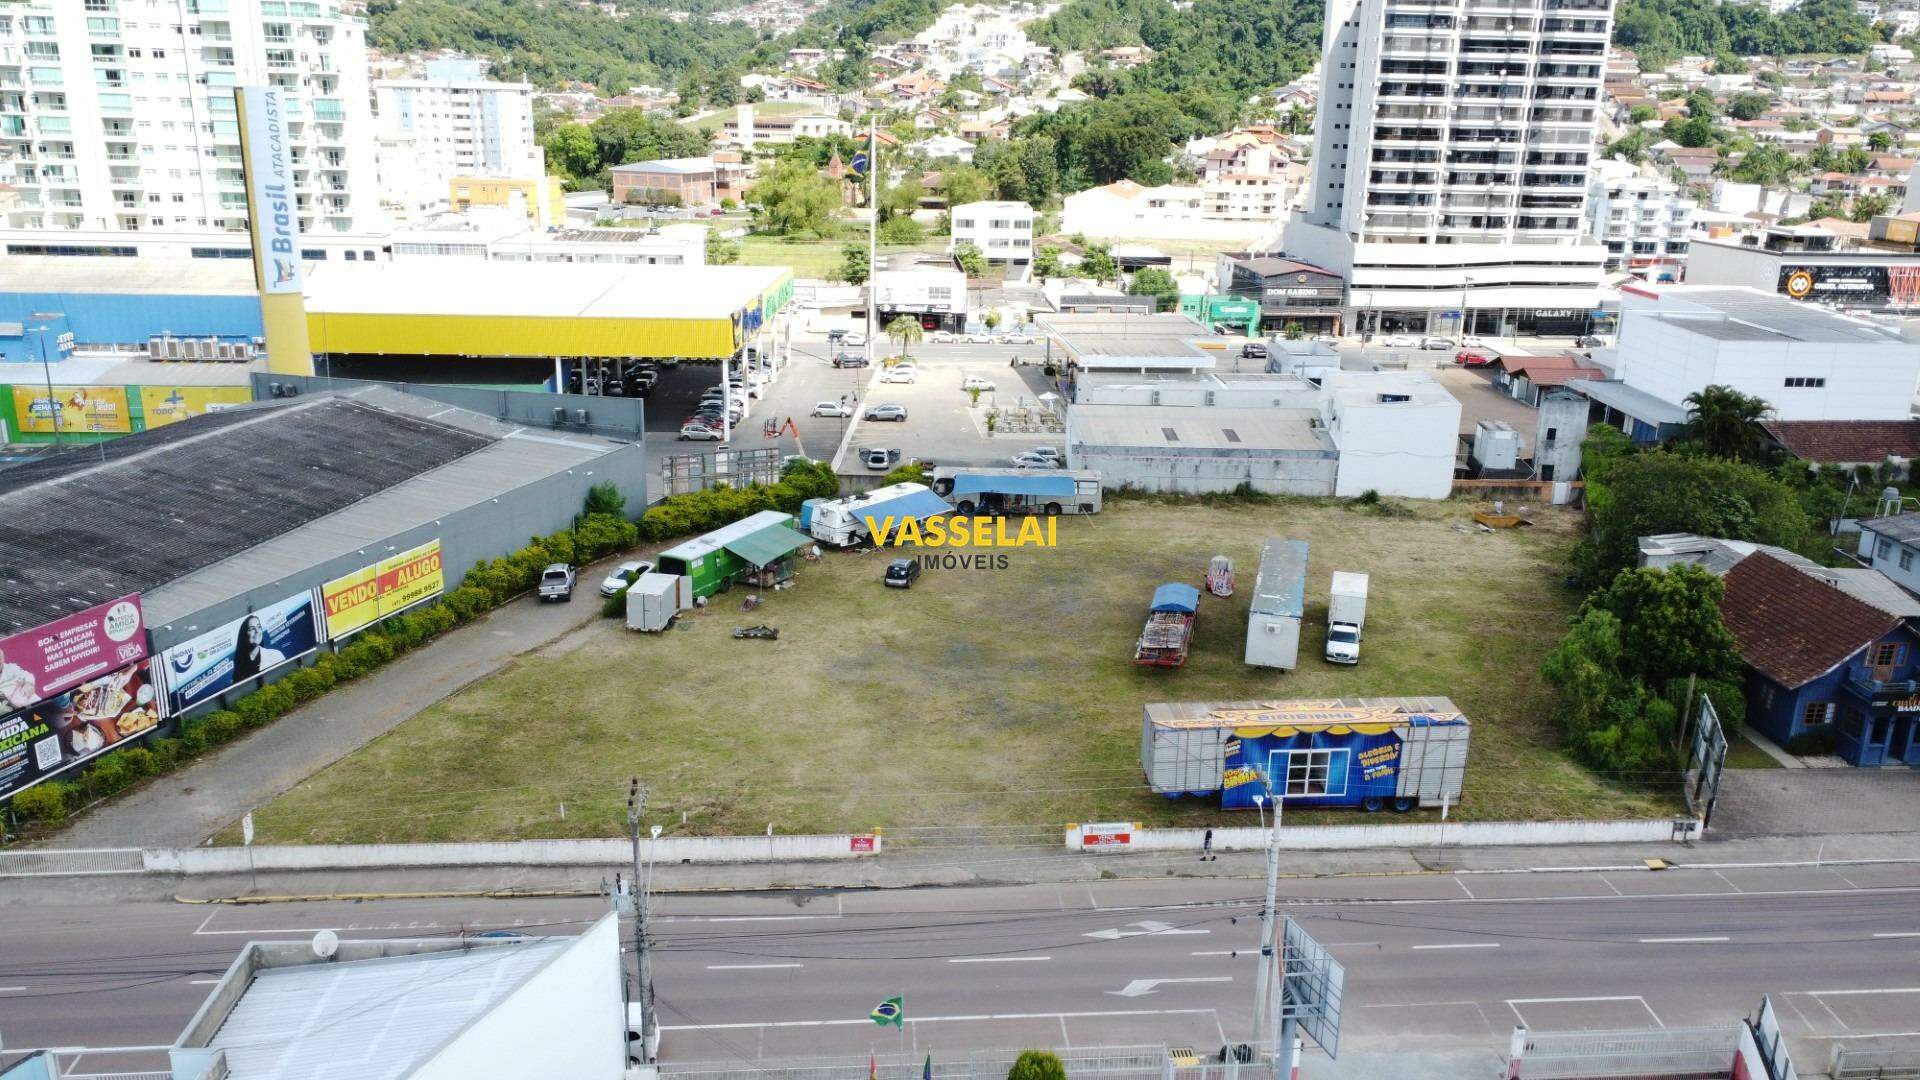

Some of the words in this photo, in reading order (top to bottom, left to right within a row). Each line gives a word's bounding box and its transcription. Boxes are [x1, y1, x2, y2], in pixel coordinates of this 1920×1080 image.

[265, 91, 284, 179] ATACADISTA
[265, 183, 293, 253] Brasil
[1535, 309, 1572, 317] GALAXY
[328, 581, 377, 614] VENDO
[397, 555, 440, 586] ALUGO
[59, 619, 98, 638] EMPRESAS
[44, 631, 95, 655] MULTIPLICAM,
[46, 650, 63, 662] MAS
[65, 638, 95, 654] TAMBÉM
[44, 657, 70, 673] SABEM
[71, 646, 100, 662] DIVIDIR!
